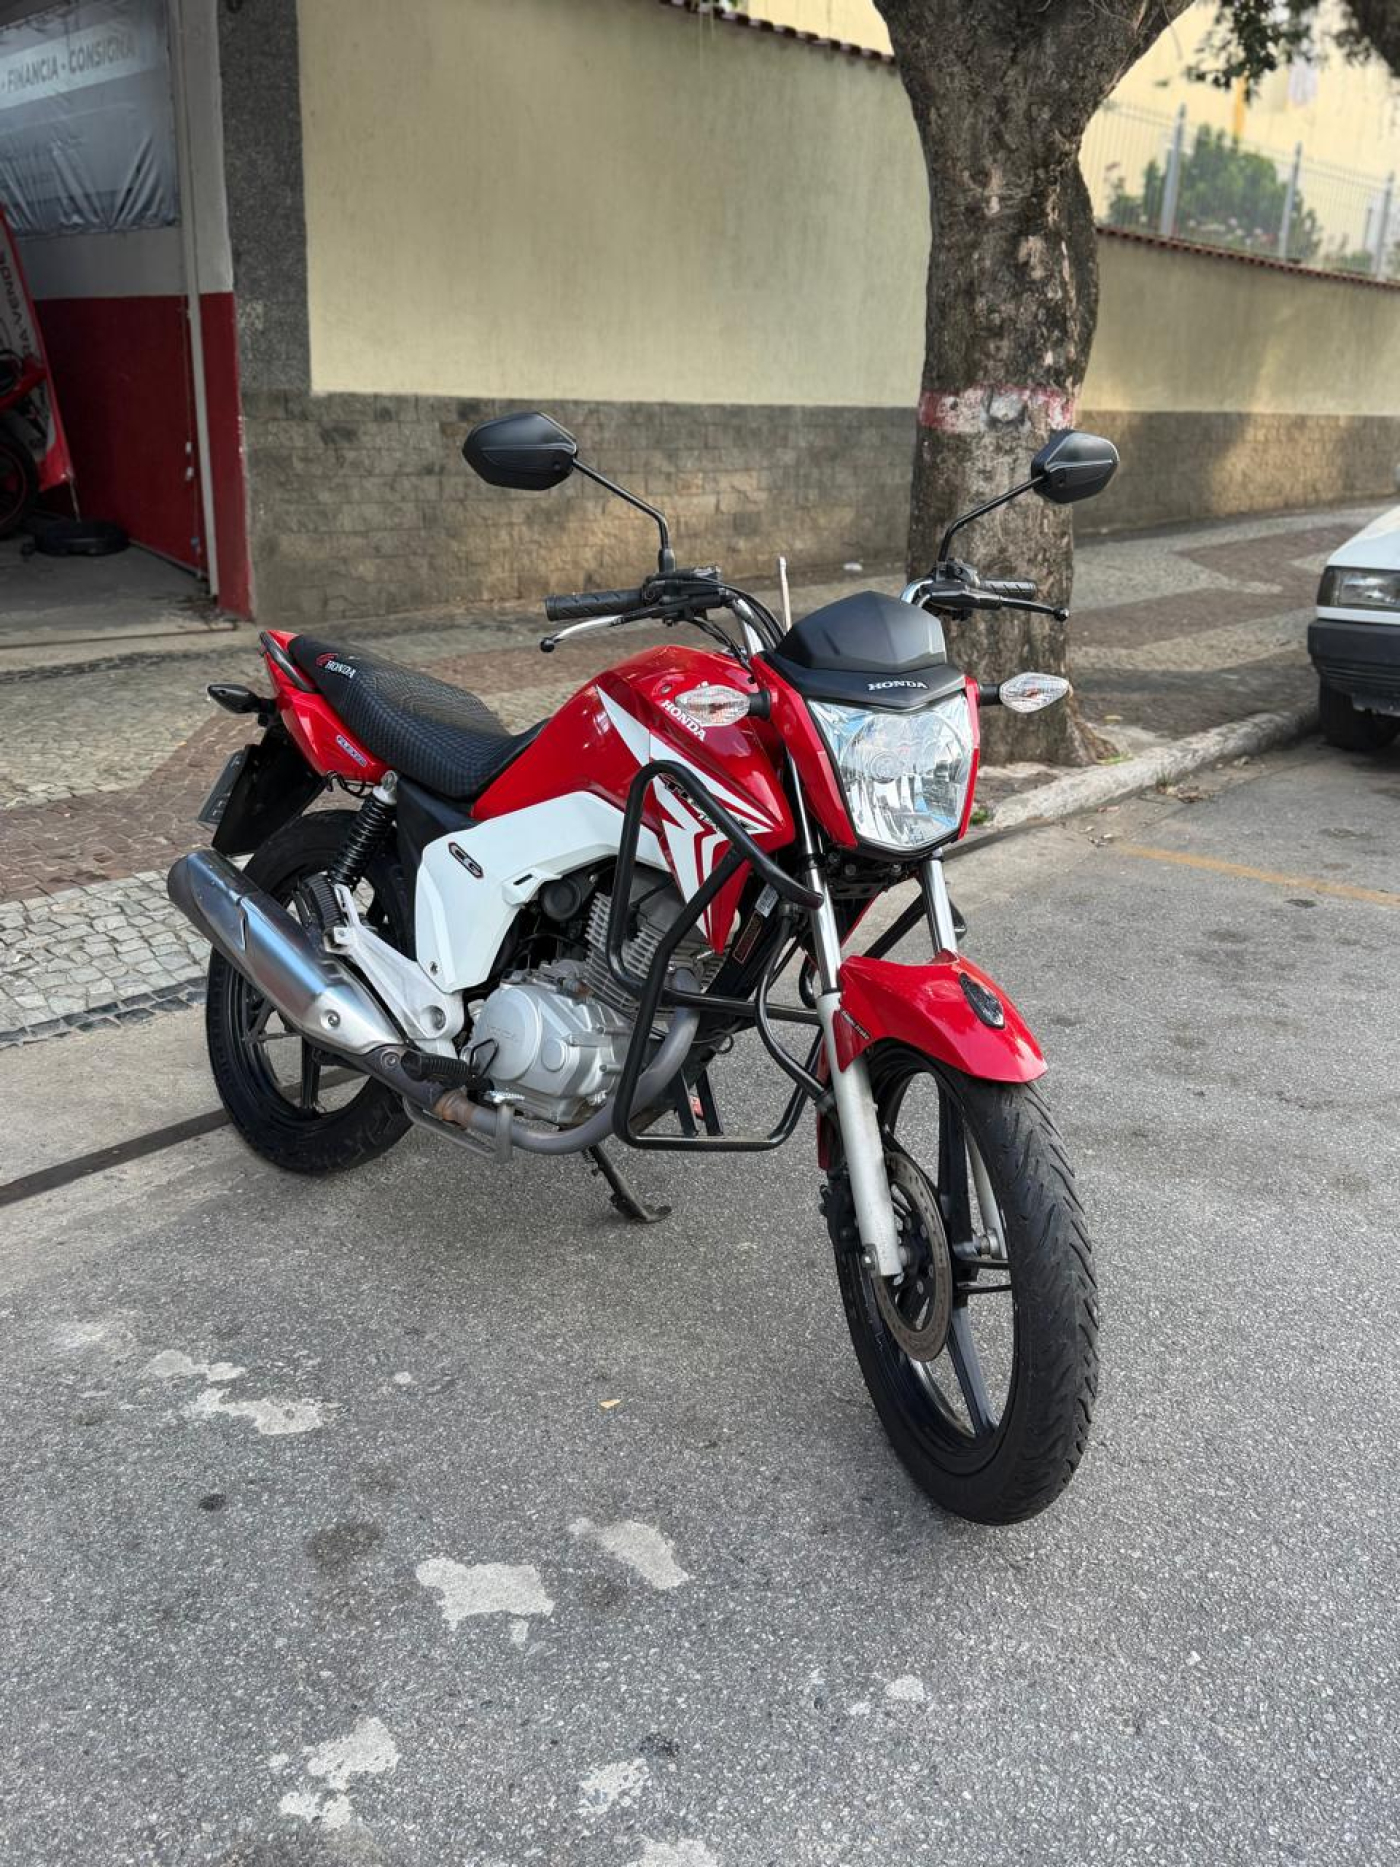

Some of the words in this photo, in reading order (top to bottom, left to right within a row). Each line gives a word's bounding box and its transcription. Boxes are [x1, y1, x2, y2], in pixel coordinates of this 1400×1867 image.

[325, 660, 356, 679] HONDA
[867, 680, 929, 691] HONDA
[661, 699, 706, 741] HONDA
[449, 843, 483, 877] CG
